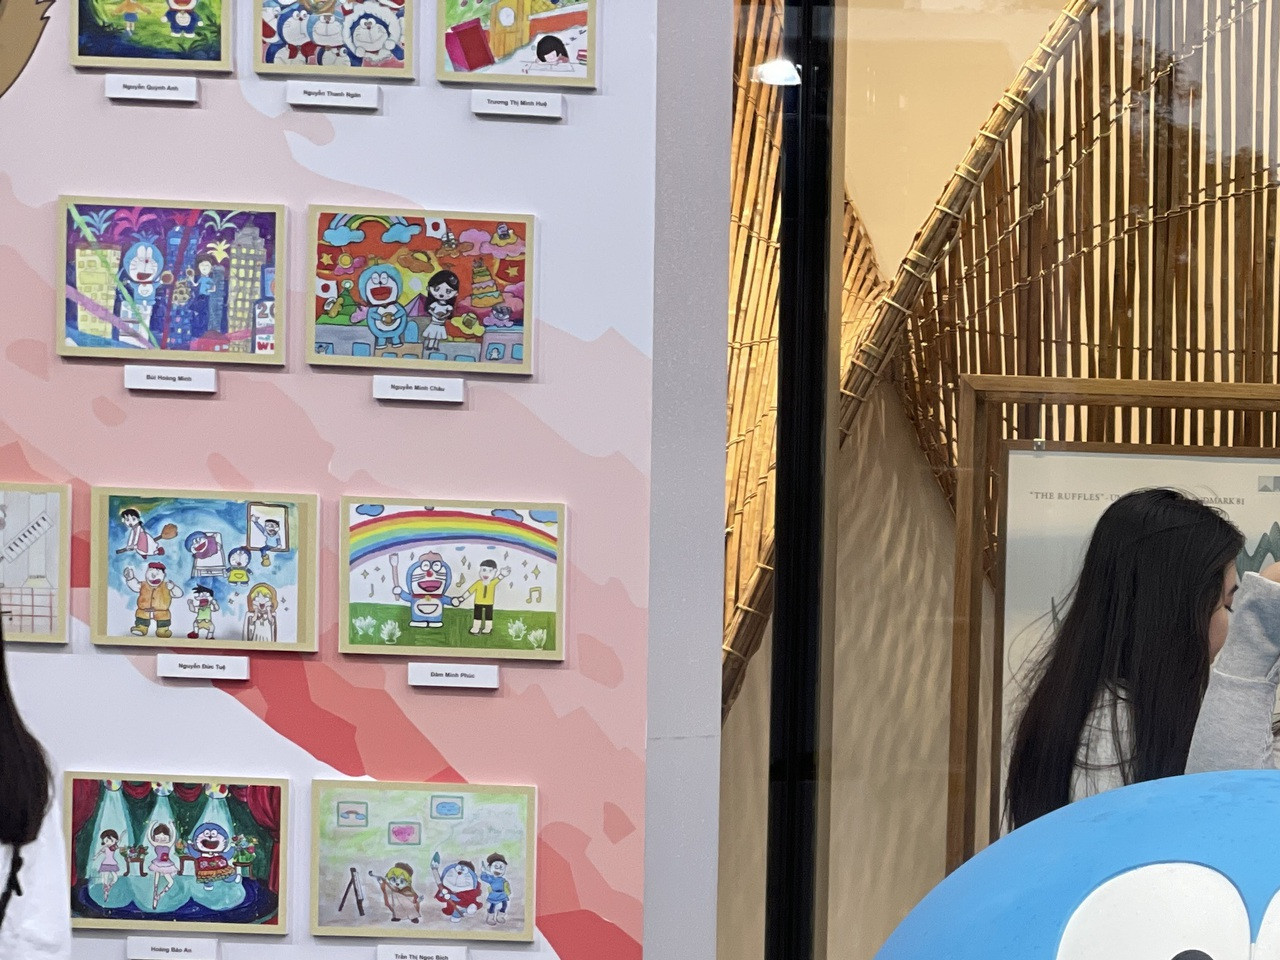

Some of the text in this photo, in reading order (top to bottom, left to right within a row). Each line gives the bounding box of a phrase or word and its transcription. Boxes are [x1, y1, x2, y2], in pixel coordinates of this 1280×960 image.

[122, 83, 145, 91] Nguyễn
[303, 89, 325, 97] Nguyễn
[487, 98, 508, 106] Trương
[536, 99, 547, 107] Huệ
[390, 383, 413, 391] Nguyễn
